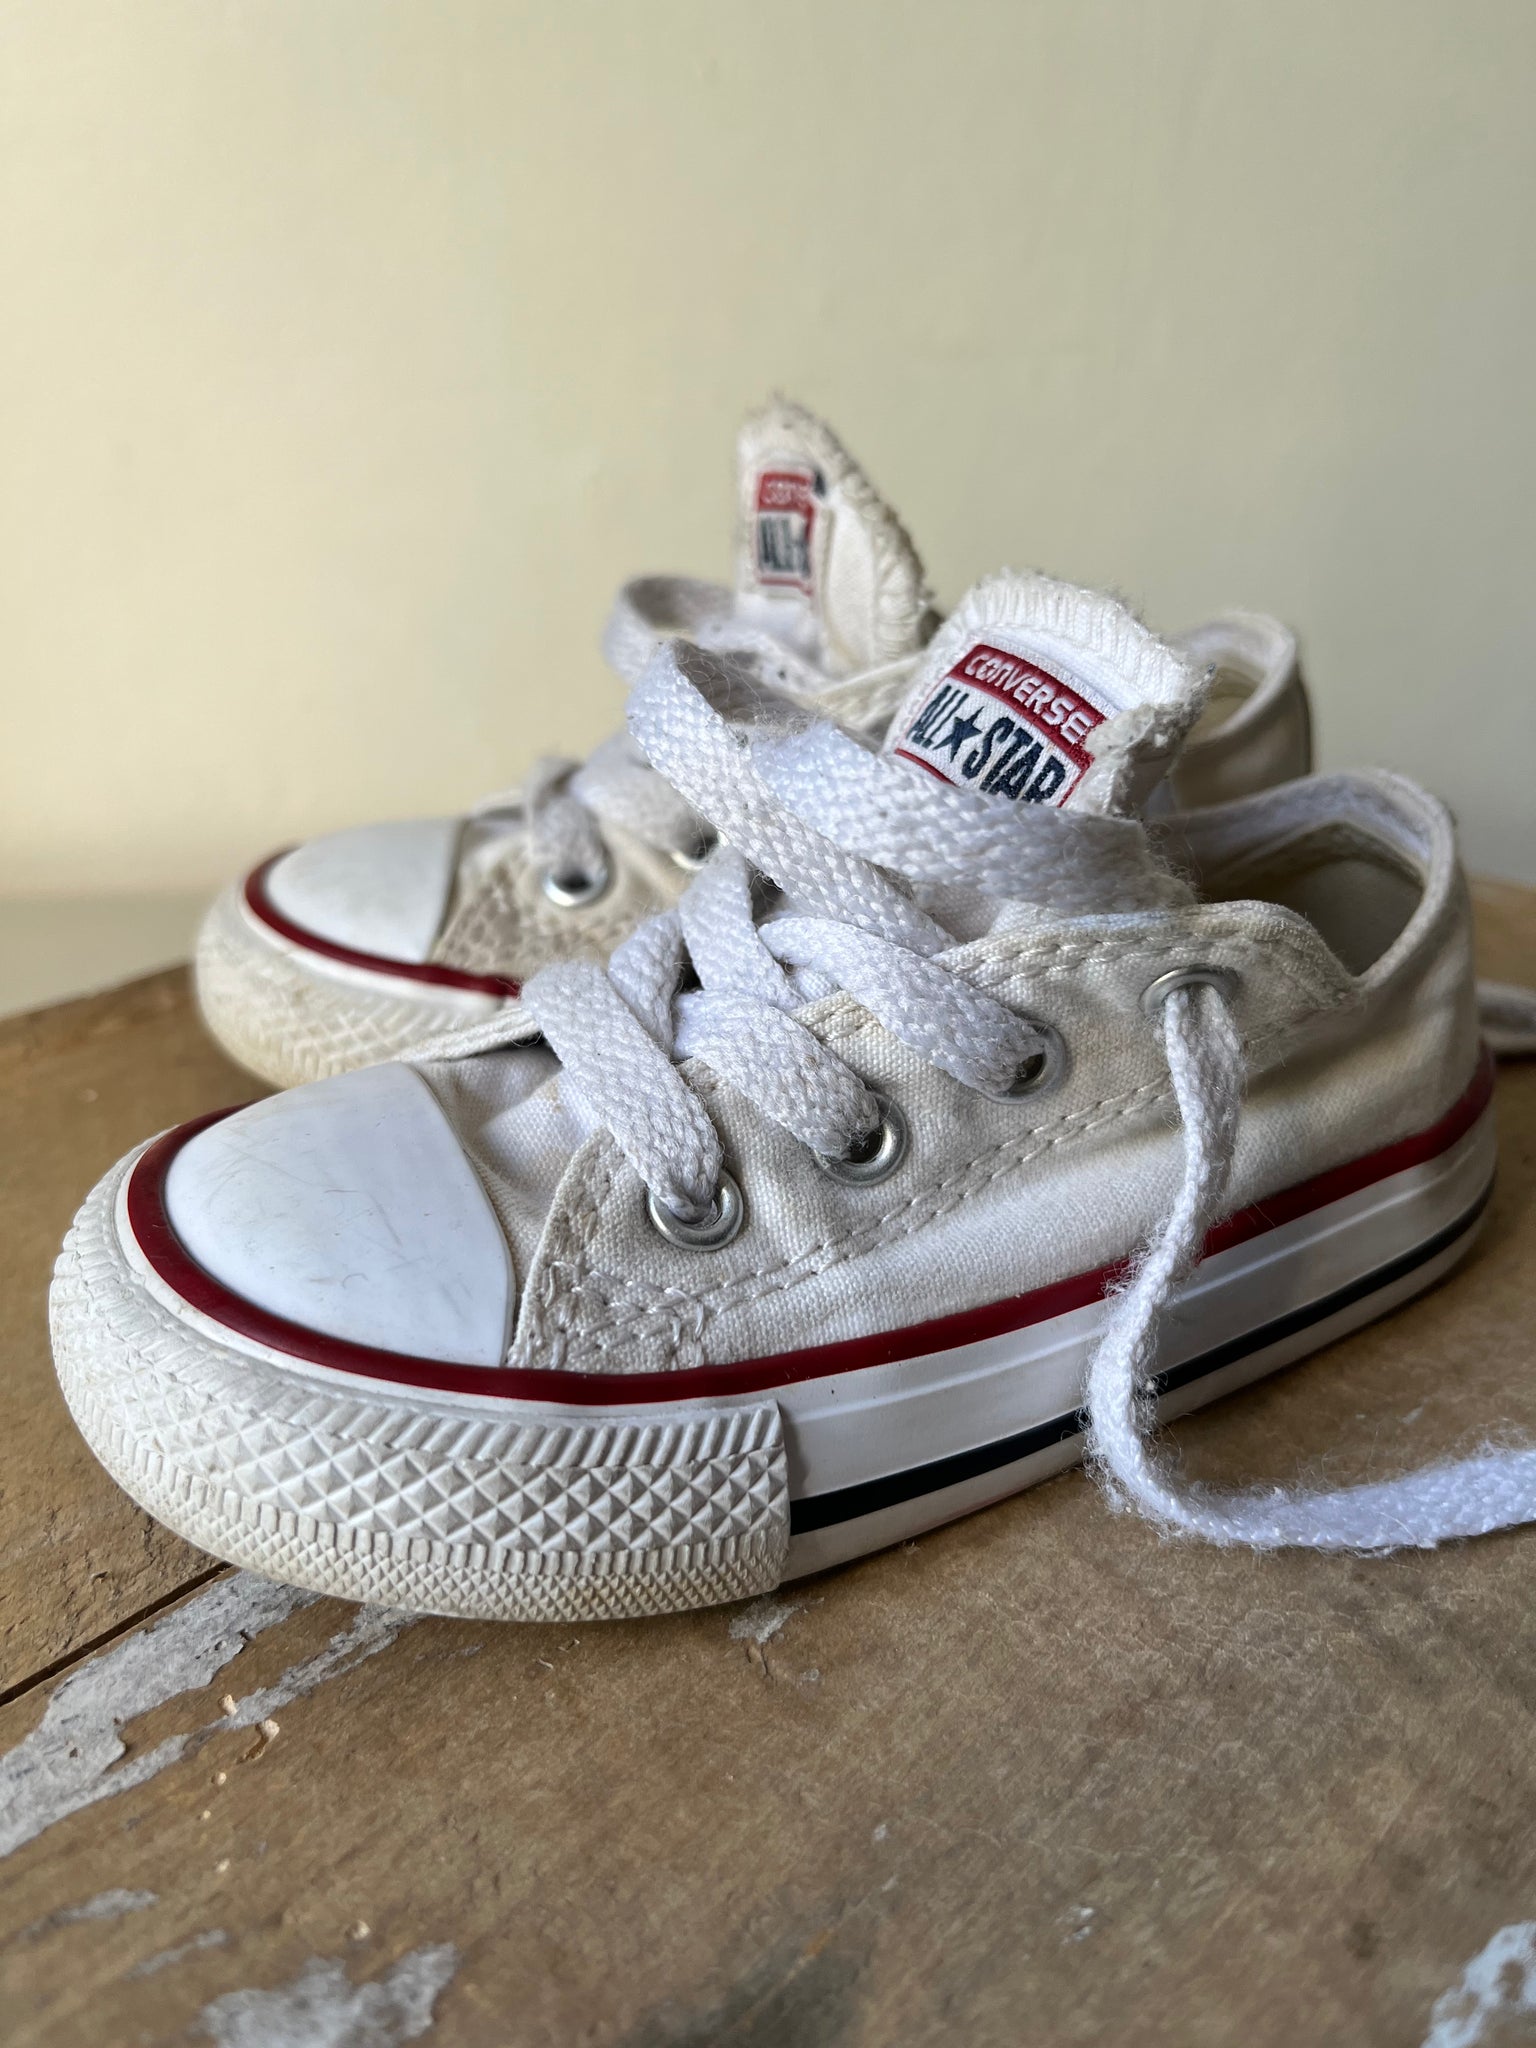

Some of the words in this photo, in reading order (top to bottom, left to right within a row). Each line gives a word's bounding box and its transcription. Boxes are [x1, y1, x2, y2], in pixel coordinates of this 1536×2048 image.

[906, 684, 970, 749] ALL
[961, 715, 1066, 805] STAR
[964, 653, 1093, 745] CONVERSE
